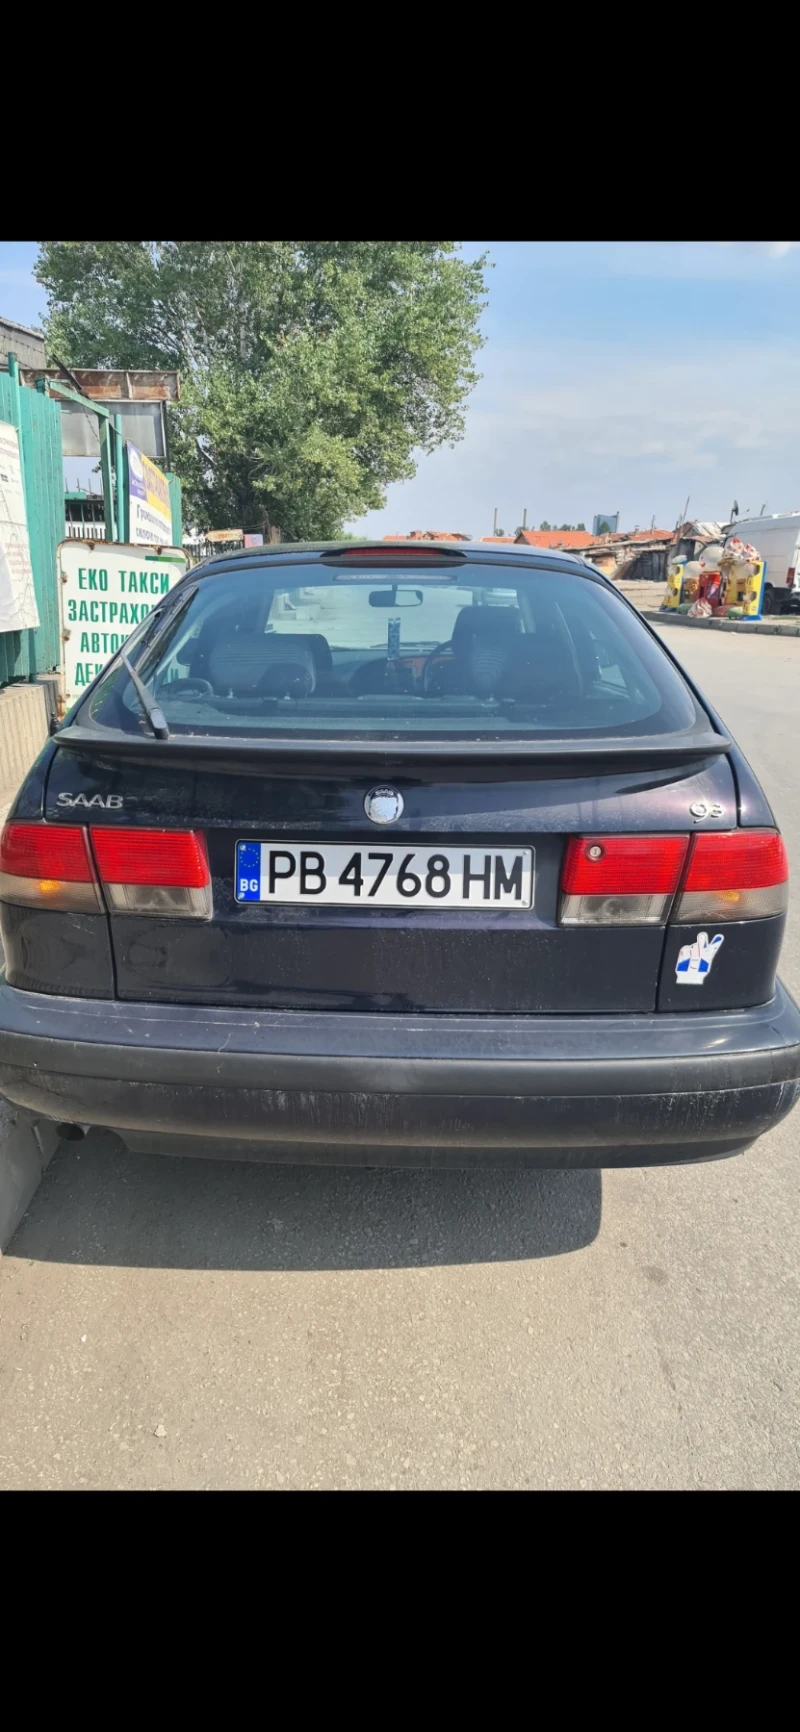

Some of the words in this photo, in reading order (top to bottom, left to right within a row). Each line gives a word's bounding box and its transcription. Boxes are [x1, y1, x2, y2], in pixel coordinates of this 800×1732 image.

[78, 568, 108, 591] ЕКО
[118, 570, 170, 594] ТАКСИ
[57, 792, 123, 809] SAAB
[240, 879, 258, 892] BG
[269, 850, 326, 894] PB
[339, 852, 451, 898] 4768
[463, 854, 523, 900] HM
